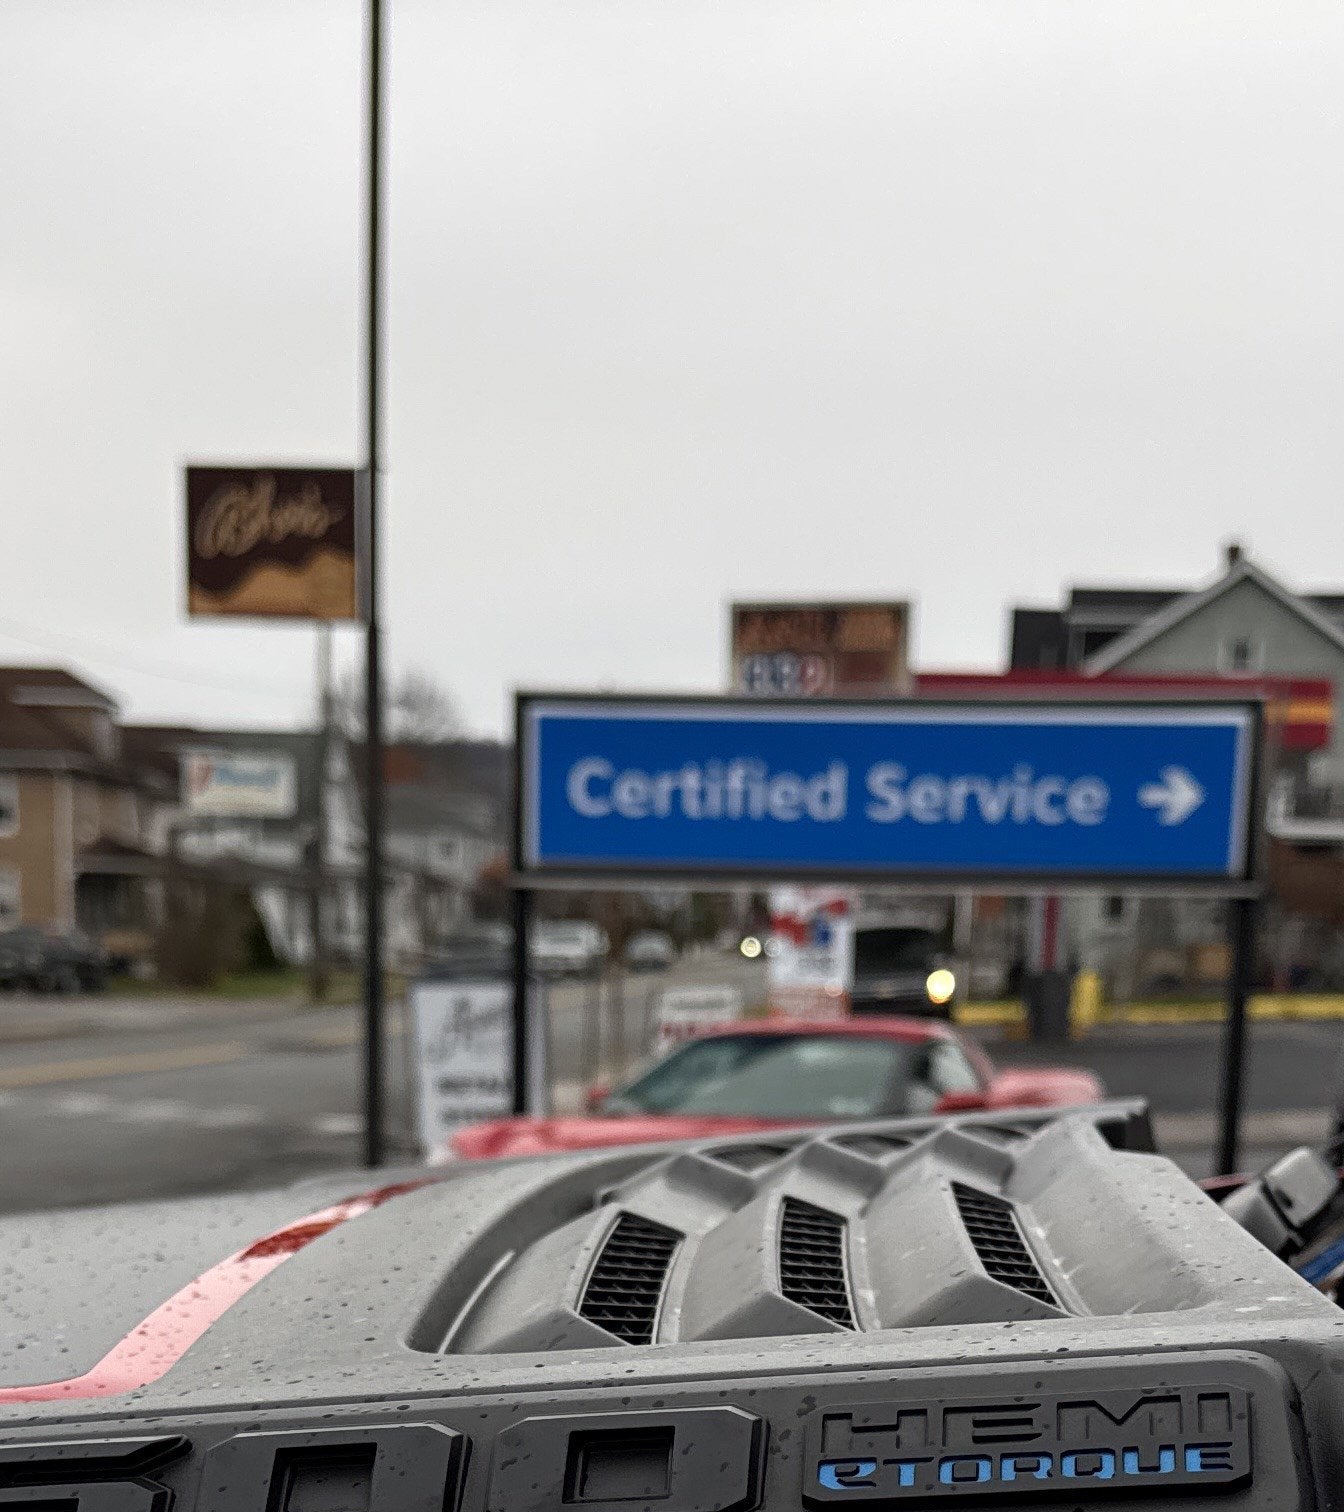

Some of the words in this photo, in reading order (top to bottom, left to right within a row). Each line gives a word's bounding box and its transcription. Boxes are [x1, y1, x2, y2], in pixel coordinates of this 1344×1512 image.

[566, 757, 848, 822] Certified
[864, 761, 1110, 827] Service
[821, 1391, 1233, 1453] HEMI
[816, 1441, 1233, 1490] eTORQUE
